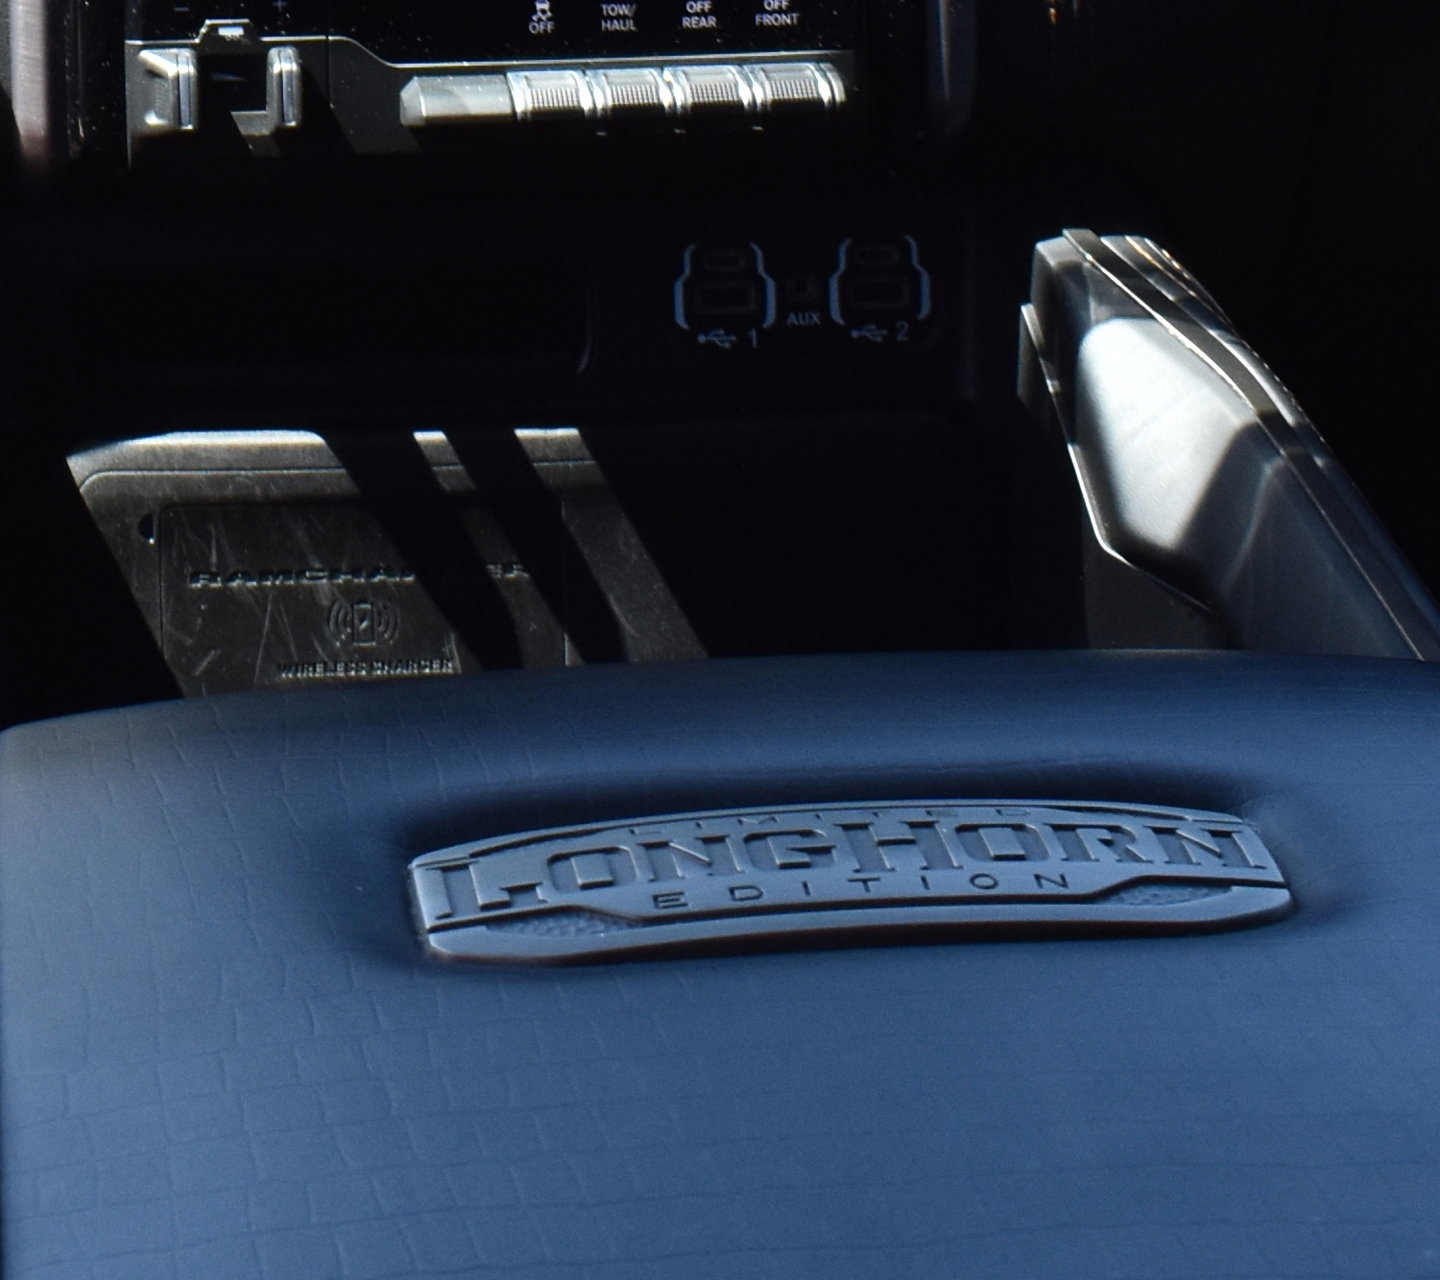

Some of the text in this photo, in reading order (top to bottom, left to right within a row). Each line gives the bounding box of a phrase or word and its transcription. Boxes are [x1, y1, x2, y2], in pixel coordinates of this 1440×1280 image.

[685, 0, 713, 14] OFF
[601, 19, 637, 32] HAUL
[682, 16, 718, 29] REAR
[755, 12, 801, 27] FRONT
[529, 22, 555, 35] OFF
[785, 311, 822, 326] AUX
[435, 818, 1268, 921] LONGHORN
[652, 869, 1069, 910] EDITION
